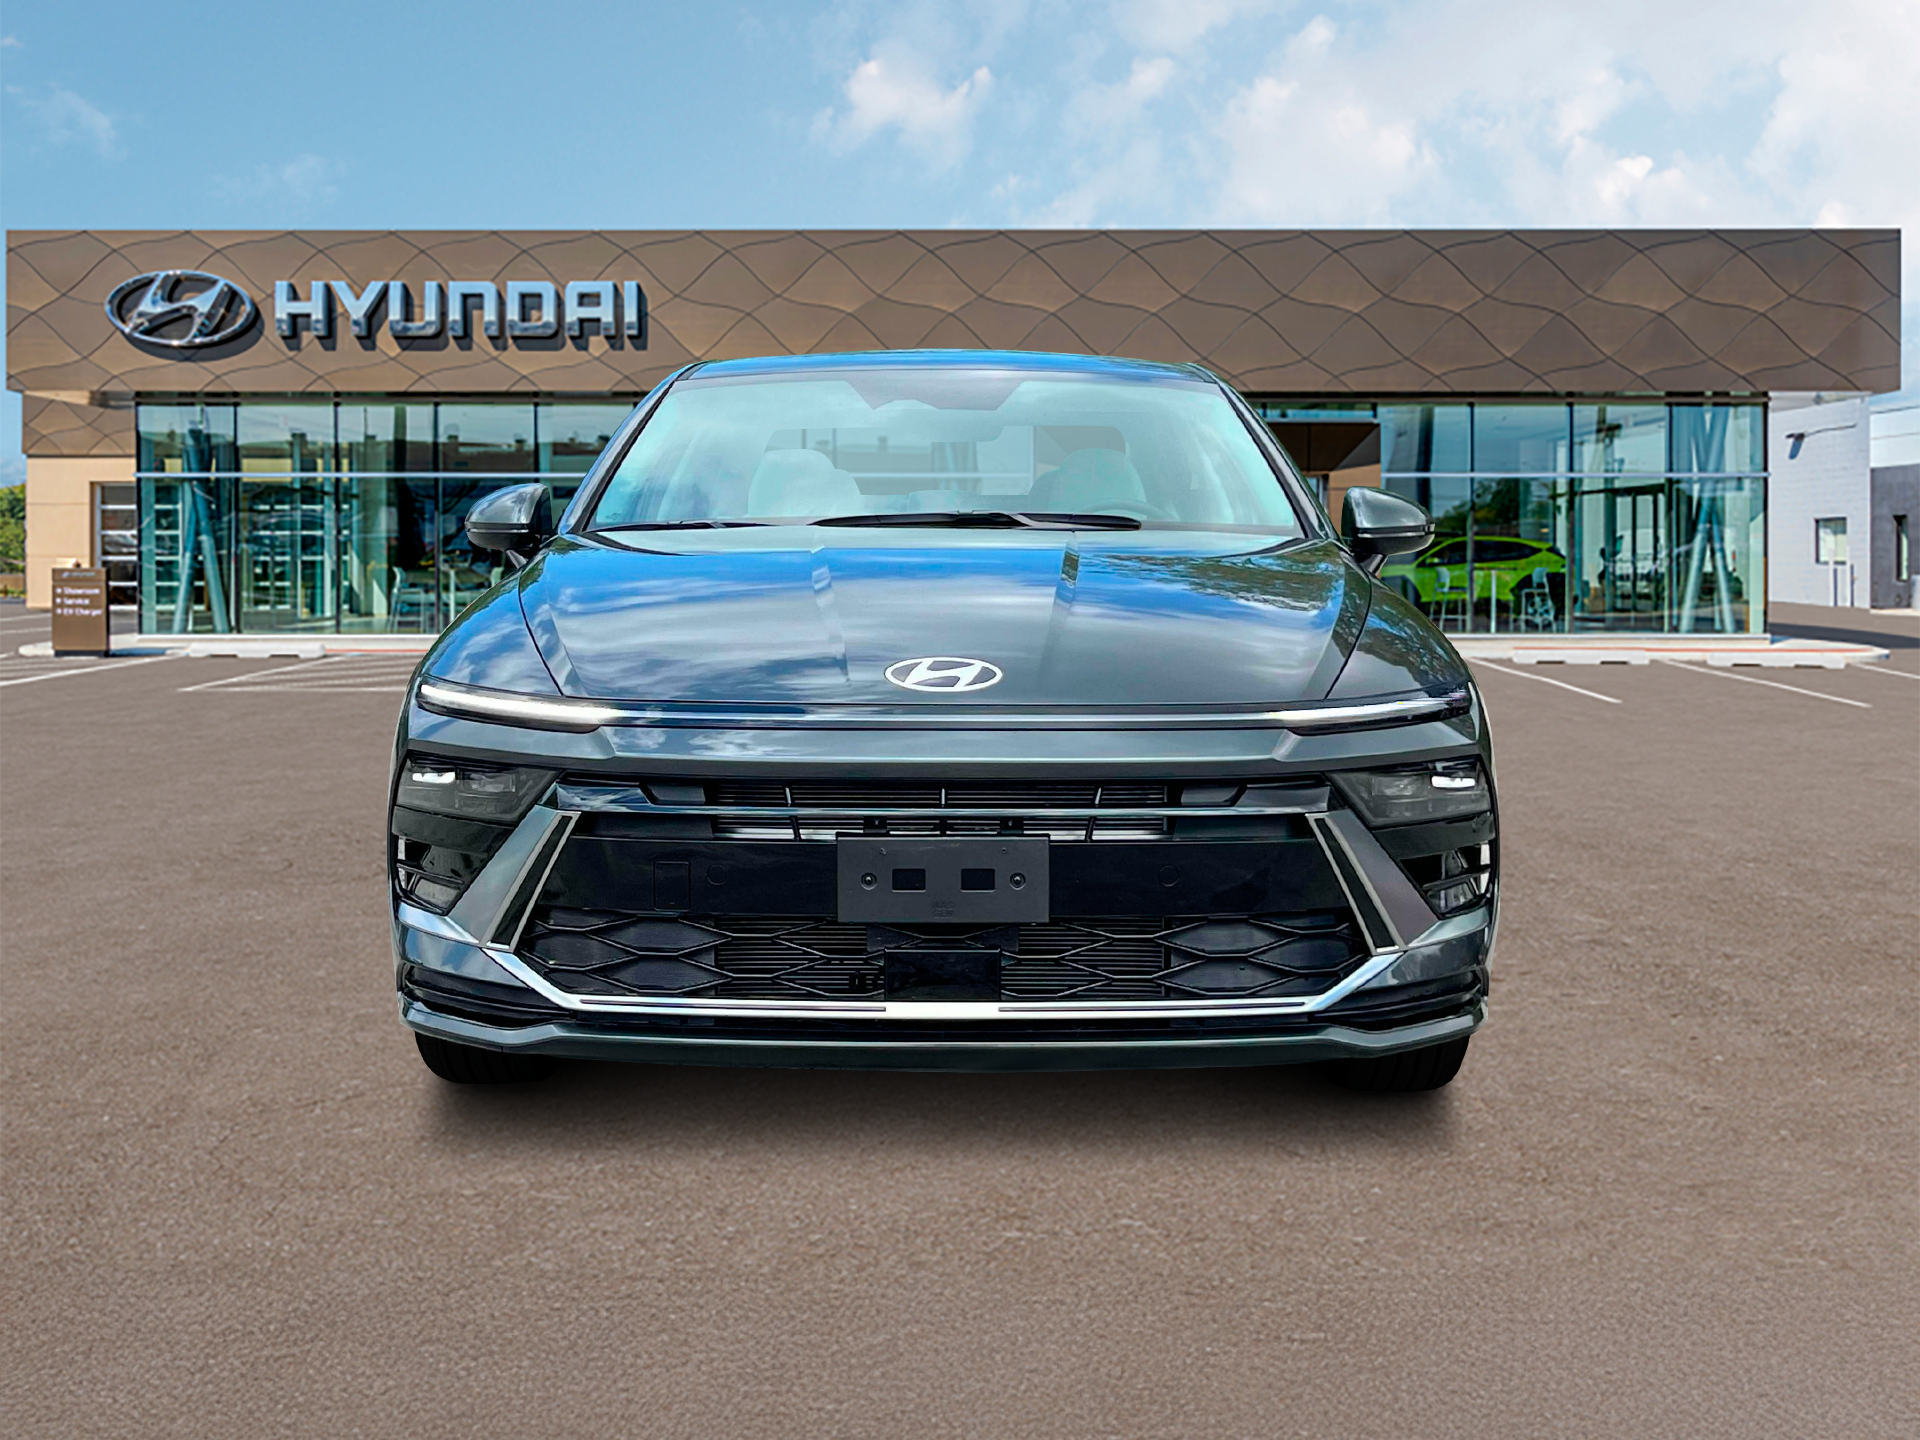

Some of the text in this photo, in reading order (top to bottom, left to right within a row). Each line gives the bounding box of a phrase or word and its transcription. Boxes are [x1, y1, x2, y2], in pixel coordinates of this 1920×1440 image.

[274, 280, 642, 340] HYUNDAI
[63, 587, 99, 595] Showroom
[63, 598, 90, 606] Service
[75, 608, 102, 617] Charger
